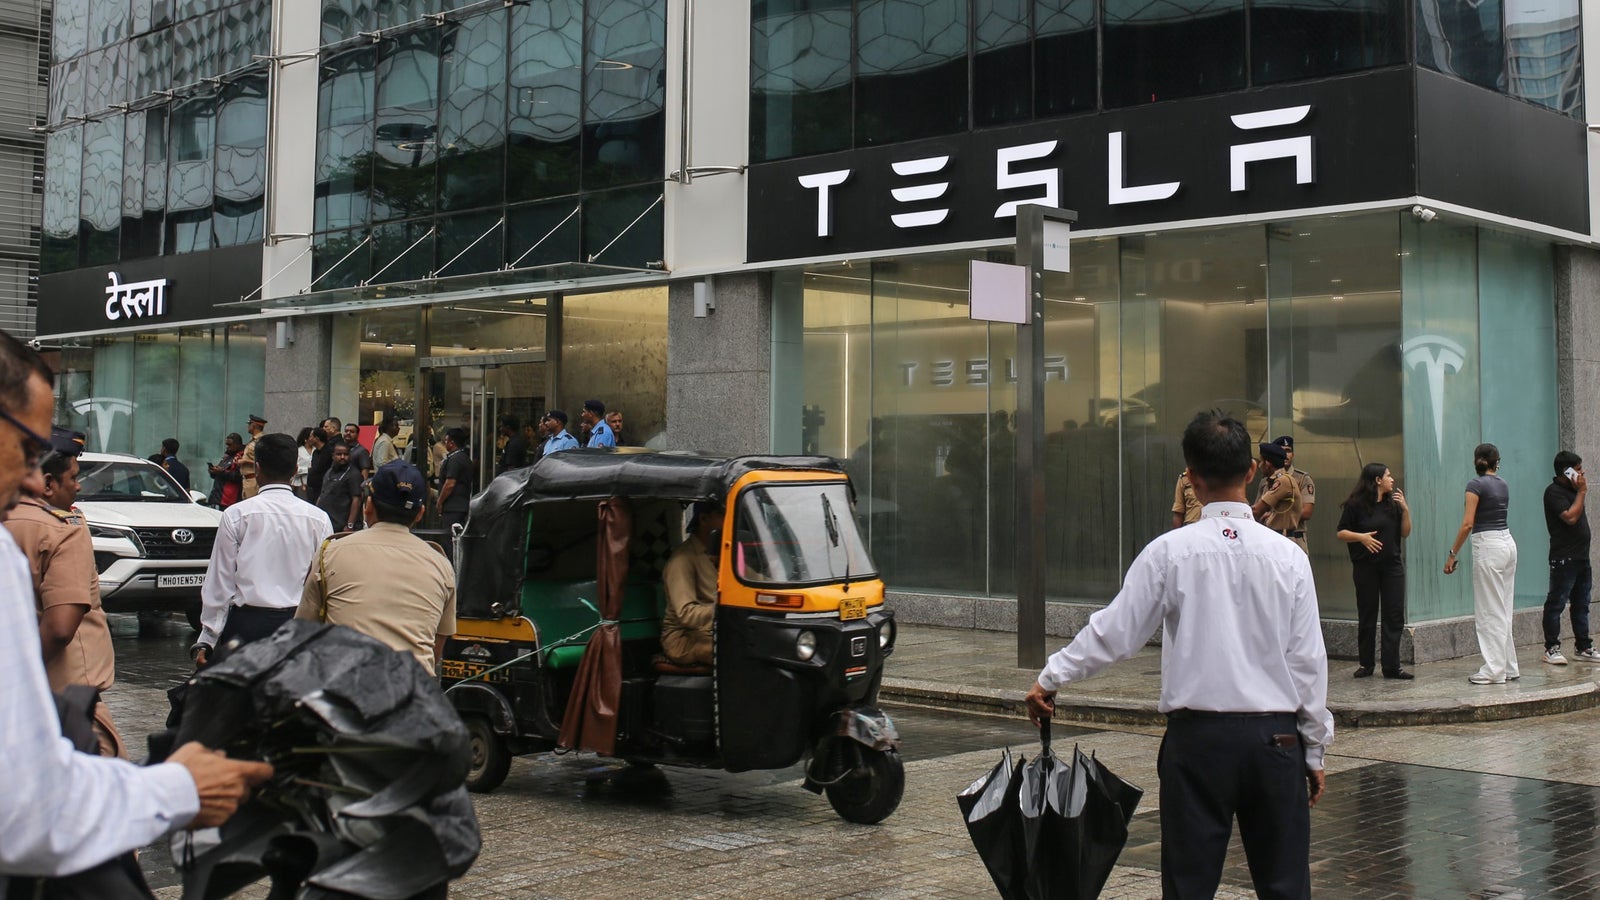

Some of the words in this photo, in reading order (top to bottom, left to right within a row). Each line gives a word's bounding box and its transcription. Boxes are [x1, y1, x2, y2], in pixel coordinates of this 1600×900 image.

[798, 105, 1314, 237] TESLA
[105, 271, 168, 320] टेस्ला
[899, 355, 1068, 388] TESLA
[359, 388, 401, 399] TESLA
[162, 575, 206, 586] MH01EN579
